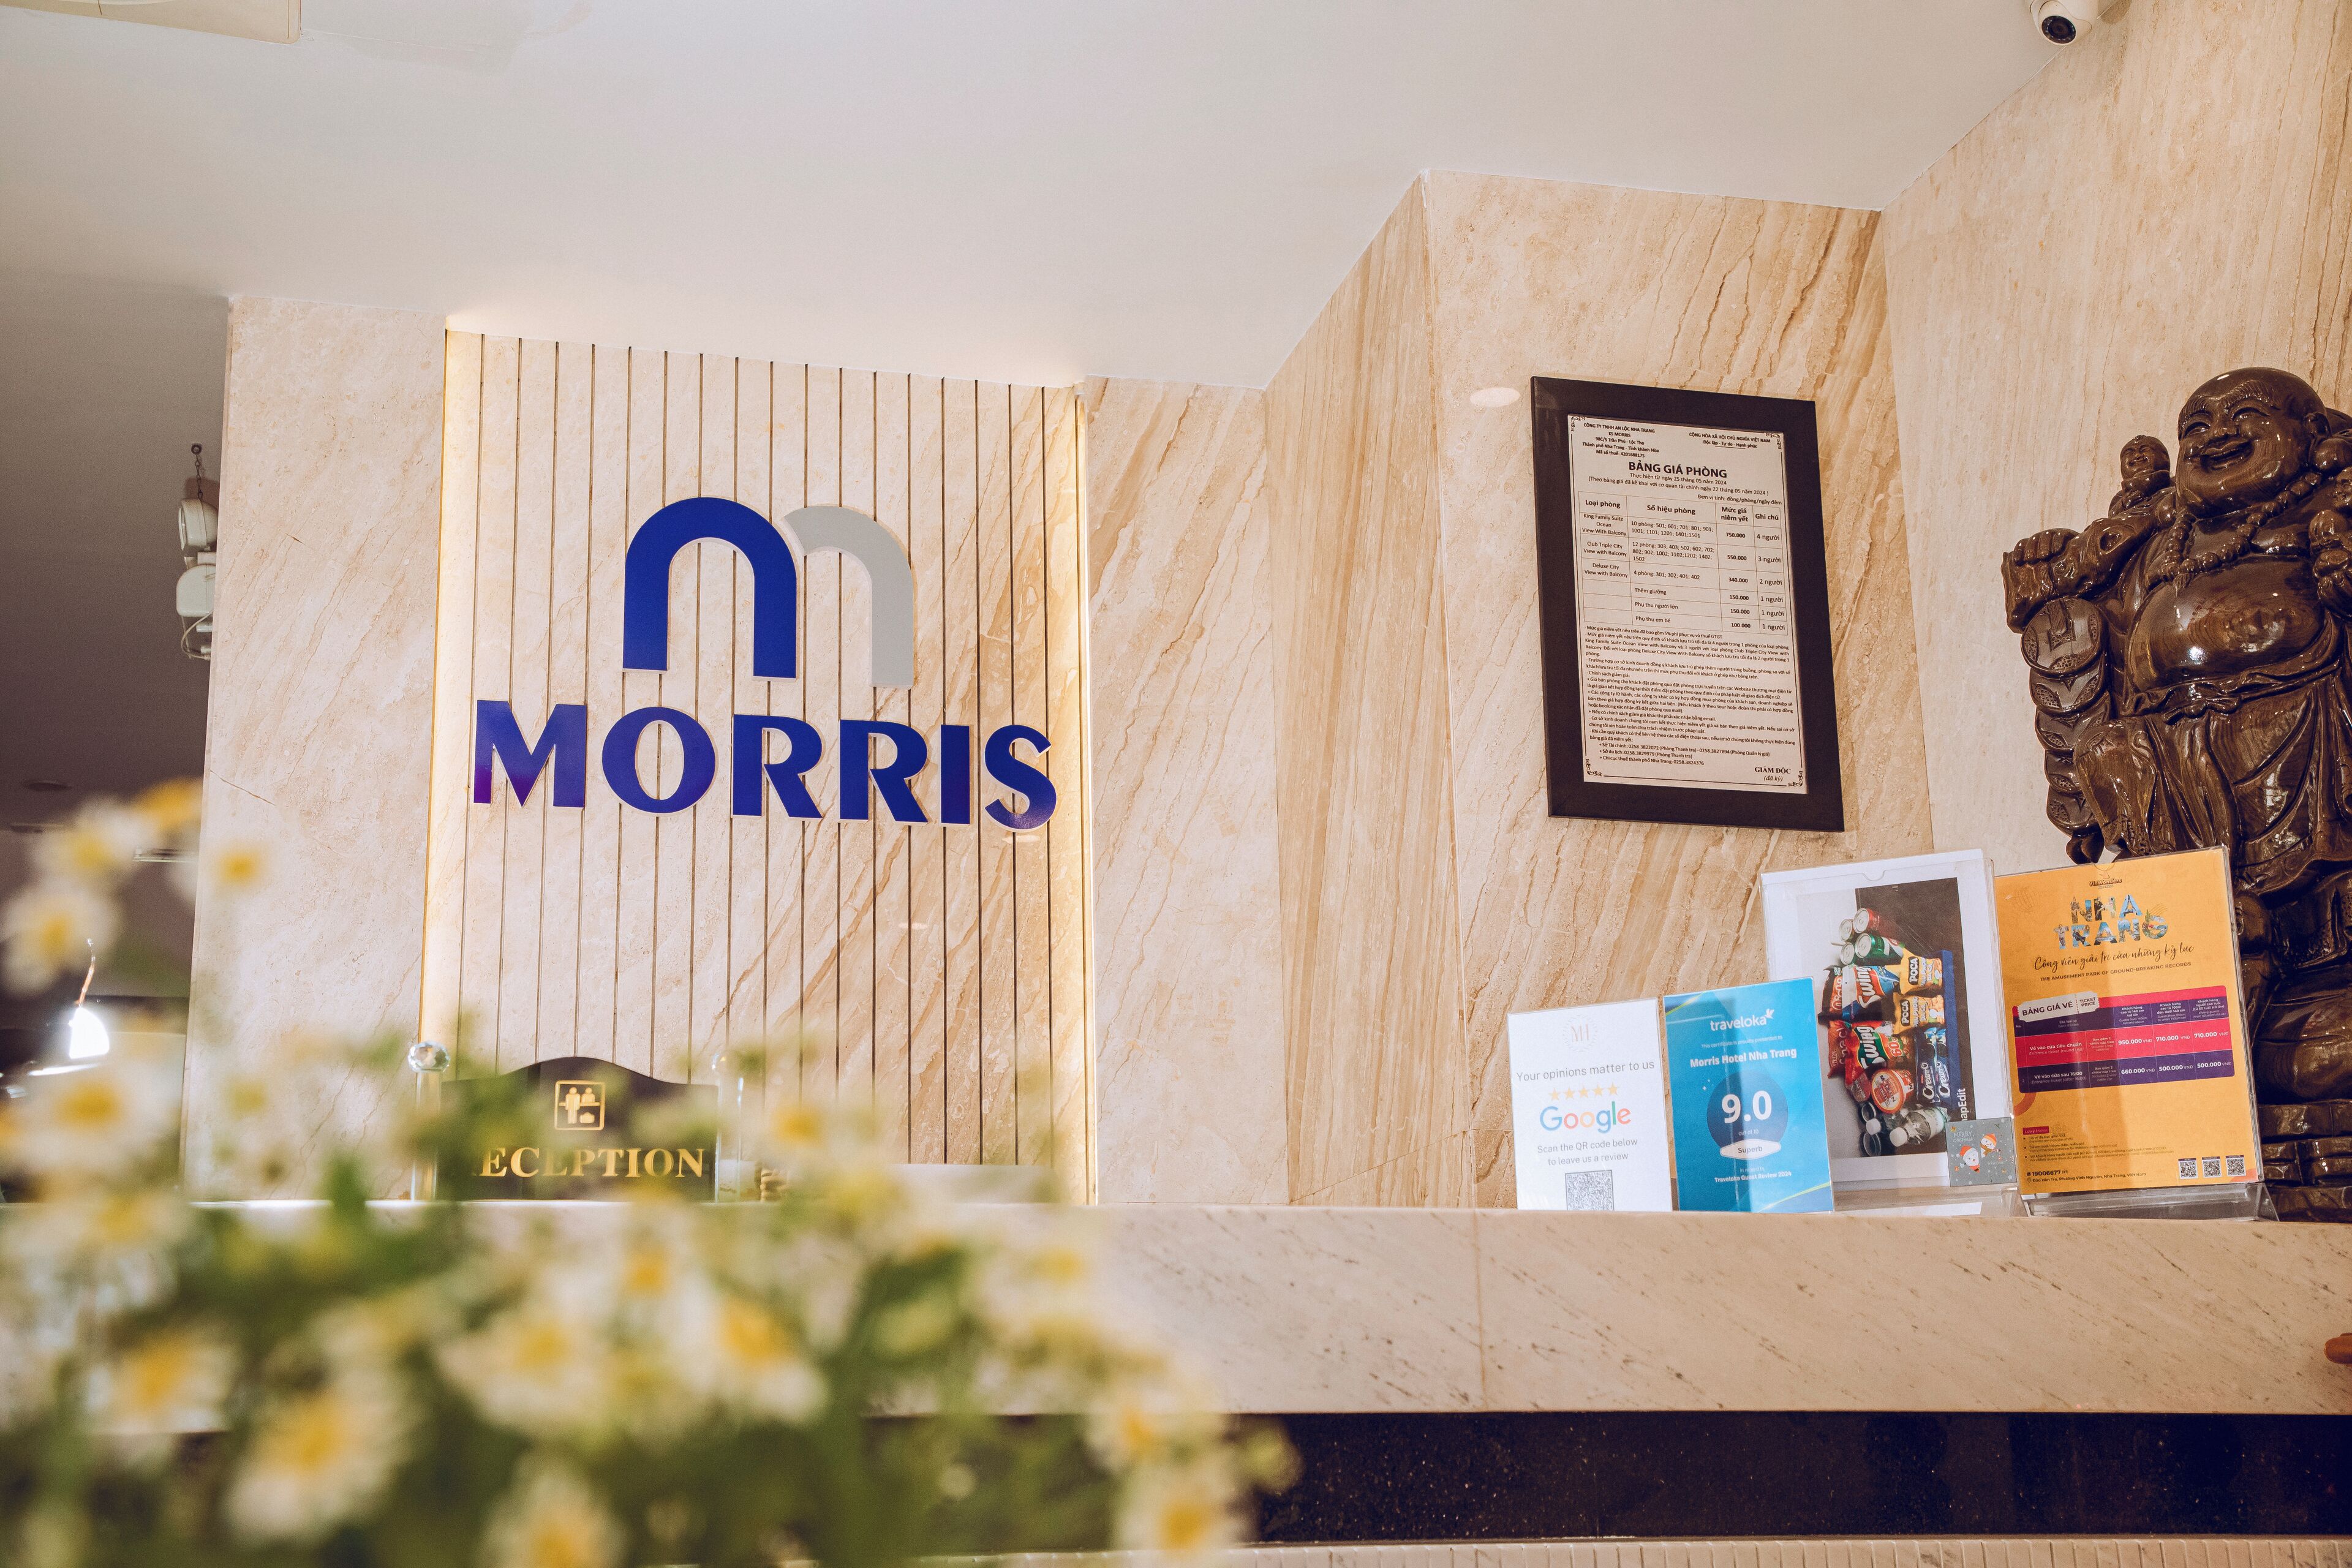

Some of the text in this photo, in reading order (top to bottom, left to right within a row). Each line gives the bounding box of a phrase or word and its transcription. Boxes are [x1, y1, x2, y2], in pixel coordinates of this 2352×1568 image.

[1628, 459, 1727, 478] BẢNG GIÁ PHÒNG
[1600, 500, 1620, 509] phòng
[1673, 507, 1695, 515] phòng
[473, 699, 1058, 831] MORRIS
[2089, 878, 2122, 887] VinWonders
[2070, 894, 2143, 924] NHA
[2053, 911, 2168, 949] TRANG
[2034, 956, 2059, 973] Công
[2060, 956, 2078, 965] viên
[2078, 954, 2098, 970] giải
[2113, 950, 2130, 960] của
[2131, 947, 2161, 962] những
[2164, 943, 2177, 960] kỷ
[2110, 964, 2163, 974] GROUND-BREAKING
[1854, 966, 1881, 1008] Swing
[2022, 1006, 2045, 1016] BẢNG
[2046, 1002, 2060, 1011] GIÁ
[1709, 1014, 1766, 1031] traveloka
[1689, 1048, 1796, 1068] Morris Hotel Nha Trang
[1856, 1027, 1887, 1069] Swing
[1516, 1061, 1654, 1081] Your opinions matter to us
[1721, 1090, 1772, 1123] 9.0
[1539, 1100, 1631, 1134] Google
[1537, 1145, 1558, 1153] Scan
[1575, 1141, 1588, 1151] QR
[1589, 1139, 1610, 1149] code
[1612, 1137, 1637, 1147] below
[1738, 1145, 1762, 1154] Superb
[471, 1147, 706, 1178] ECEPTION
[1558, 1156, 1580, 1165] leave
[1600, 1152, 1629, 1161] review
